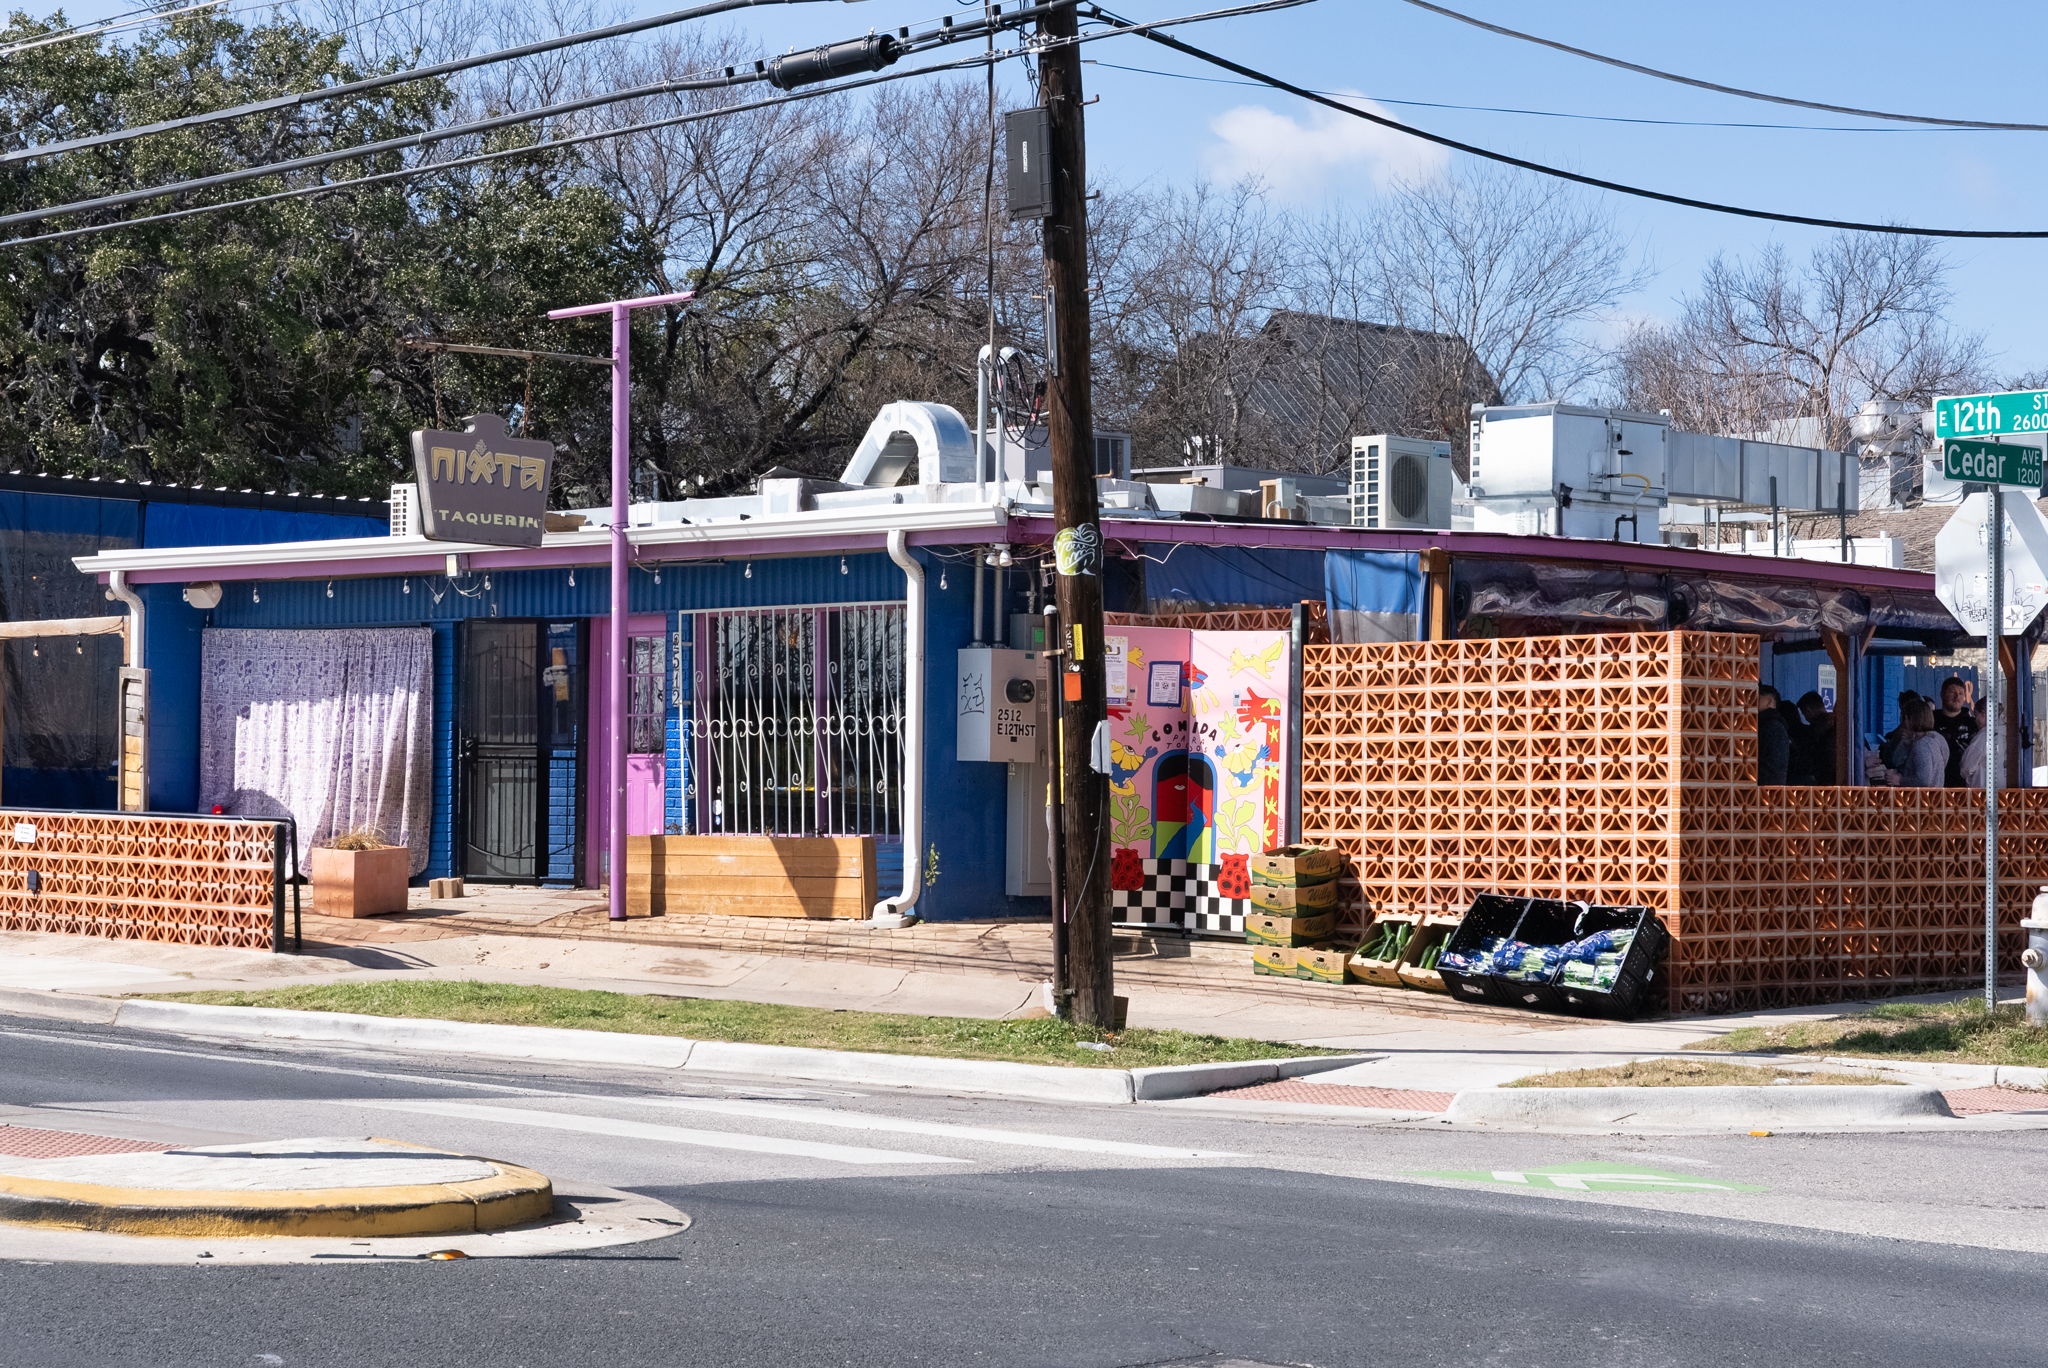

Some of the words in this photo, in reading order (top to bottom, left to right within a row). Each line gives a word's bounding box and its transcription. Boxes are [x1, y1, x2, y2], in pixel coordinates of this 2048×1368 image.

[2033, 393, 2048, 410] ST
[1939, 411, 1948, 427] E
[1953, 400, 2001, 433] 12th
[2013, 413, 2048, 431] 2600
[1947, 444, 2007, 479] Cedar
[2021, 449, 2041, 466] AVE
[2017, 467, 2041, 485] 1200
[997, 708, 1022, 722] 2512
[1152, 720, 1217, 742] COMIDA
[1173, 734, 1205, 745] PARA
[1166, 743, 1208, 753] TODOS
